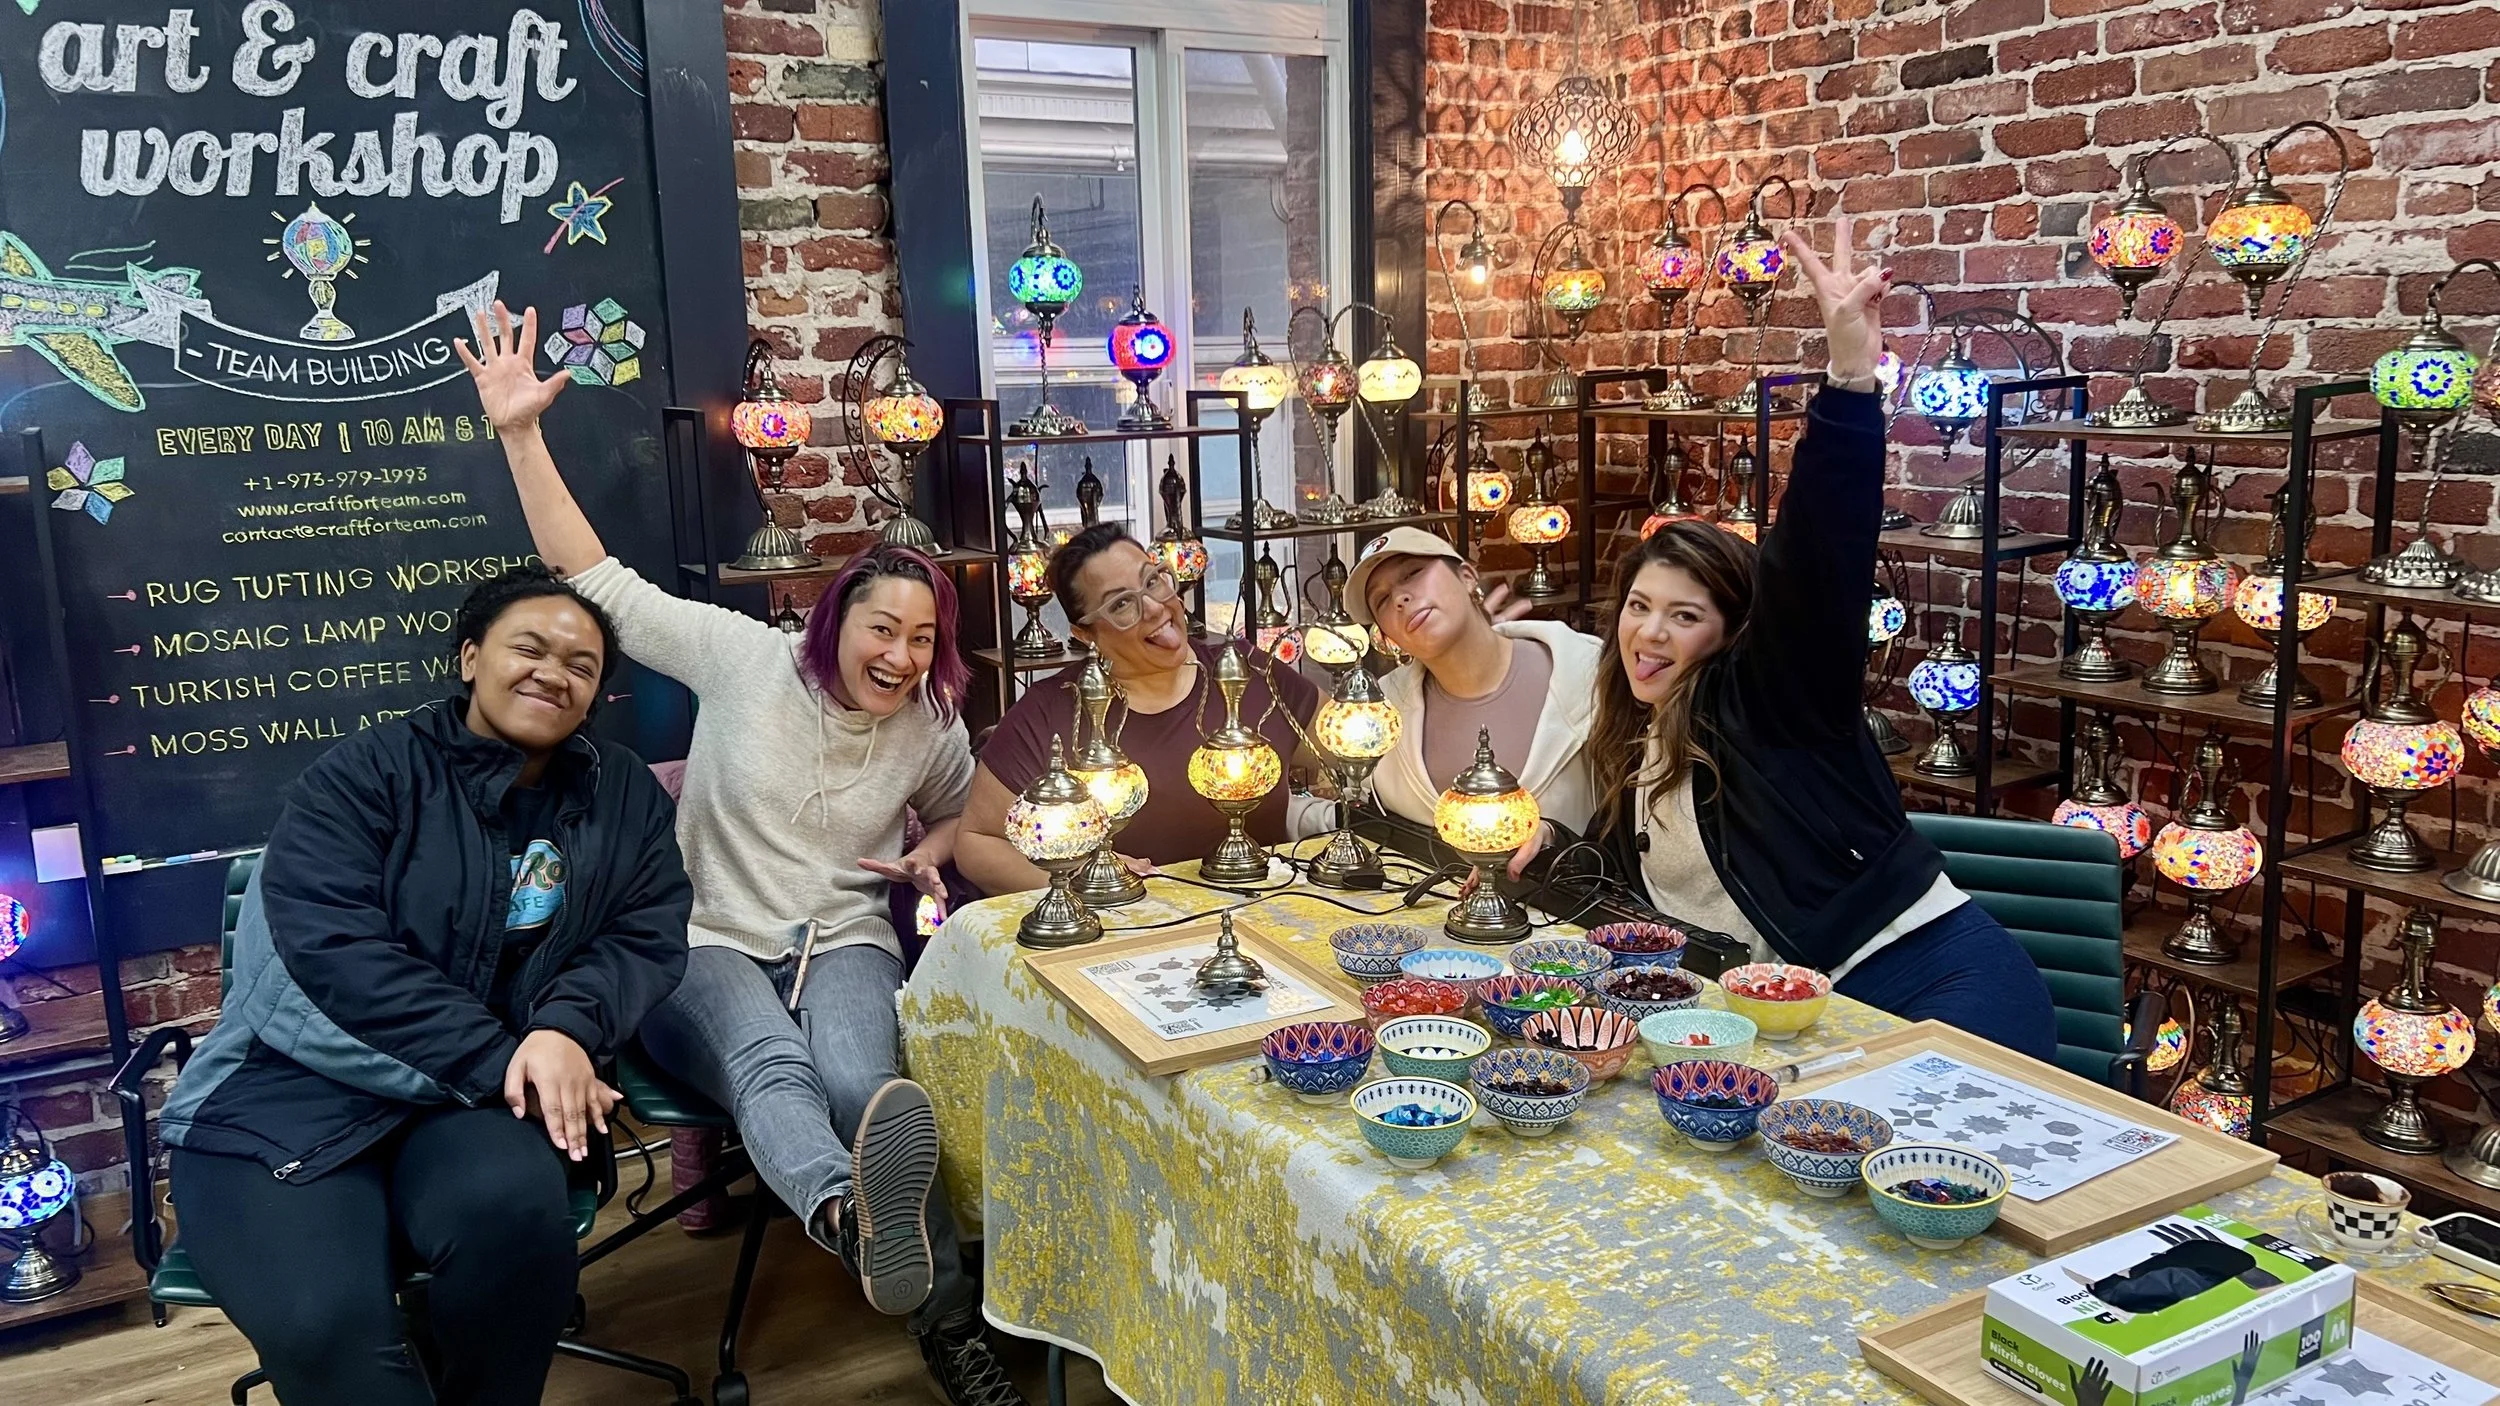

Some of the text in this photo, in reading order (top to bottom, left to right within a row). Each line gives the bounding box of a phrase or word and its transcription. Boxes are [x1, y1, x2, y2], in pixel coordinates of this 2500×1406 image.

[39, 0, 578, 129] art & craft
[80, 107, 558, 224] workshop
[208, 338, 450, 386] TEAM BUILDING
[156, 426, 254, 456] EVERY
[265, 422, 322, 451] DAY
[361, 419, 394, 446] 10
[402, 412, 444, 444] AM
[243, 466, 428, 491] +1-973-979-1993
[237, 491, 466, 518] www.craftforteam.com
[222, 514, 487, 544] contact@craftforteam.com
[146, 579, 221, 607] RUG
[232, 568, 374, 602] TUFTING
[154, 608, 460, 658] MOSAIC LAMP WO
[131, 674, 277, 709] TURKISH
[288, 661, 412, 692] COFFEE
[150, 727, 249, 758] MOSS
[258, 717, 346, 745] WALL
[507, 896, 545, 914] AFE
[2277, 1245, 2321, 1263] M
[2056, 1289, 2091, 1305] Blac
[1991, 1328, 2020, 1353] Black
[2301, 1329, 2322, 1350] 100
[2329, 1319, 2346, 1343] M
[1989, 1341, 2025, 1369] Nitrile
[2025, 1361, 2067, 1393] Gloves
